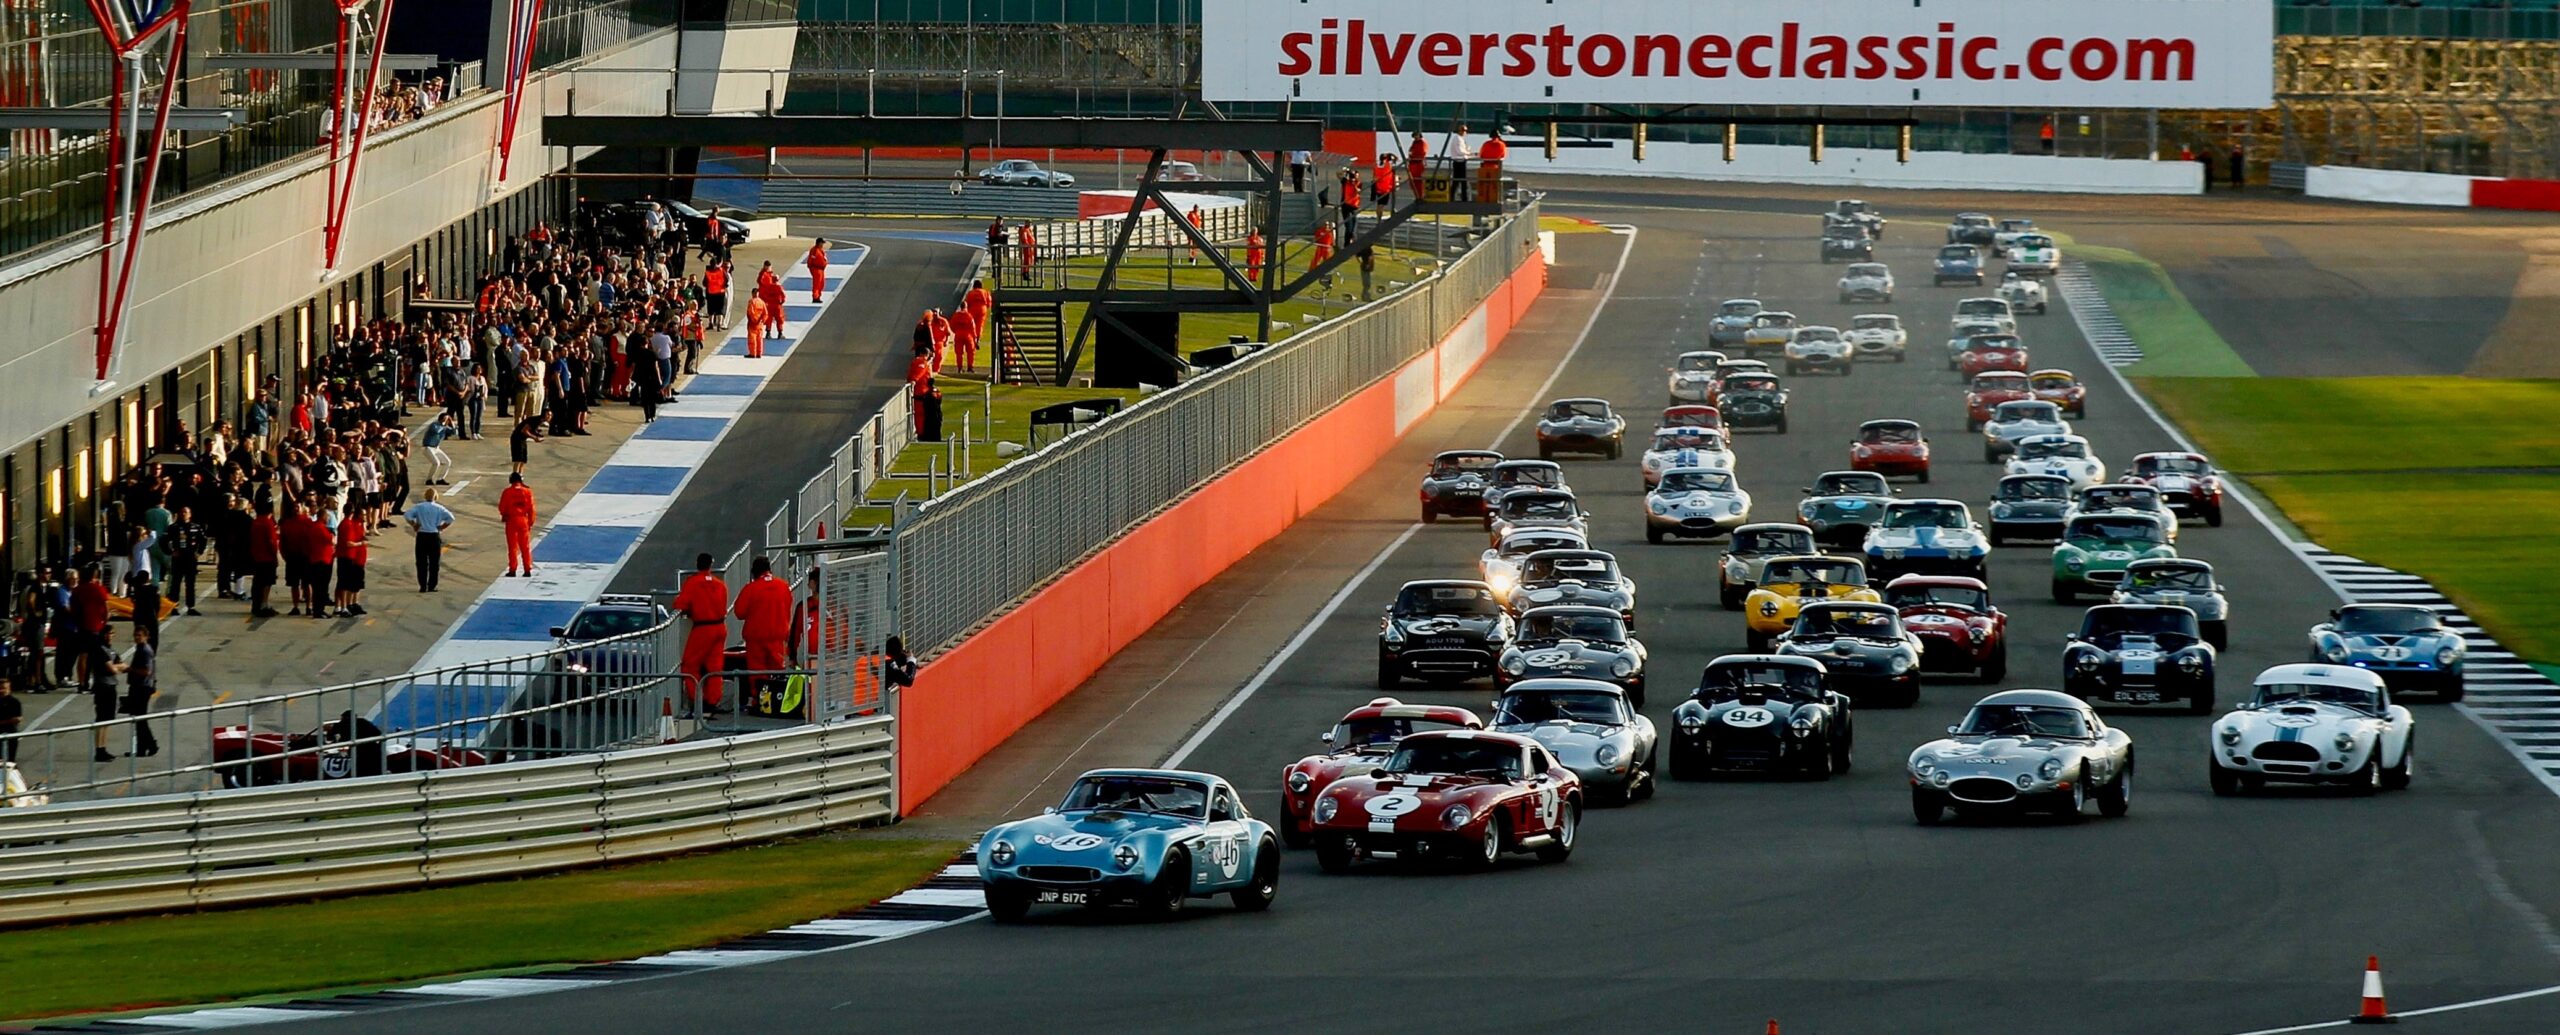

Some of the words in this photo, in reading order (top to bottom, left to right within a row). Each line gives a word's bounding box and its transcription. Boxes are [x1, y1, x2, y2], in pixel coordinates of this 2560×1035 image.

[1278, 18, 2195, 81] silverstoneclassic.com
[1730, 710, 1766, 722] 94
[1381, 797, 1404, 811] 2
[1054, 835, 1102, 846] 46
[1221, 836, 1239, 867] 46
[1037, 891, 1059, 902] JNP
[1062, 892, 1088, 904] 617C
